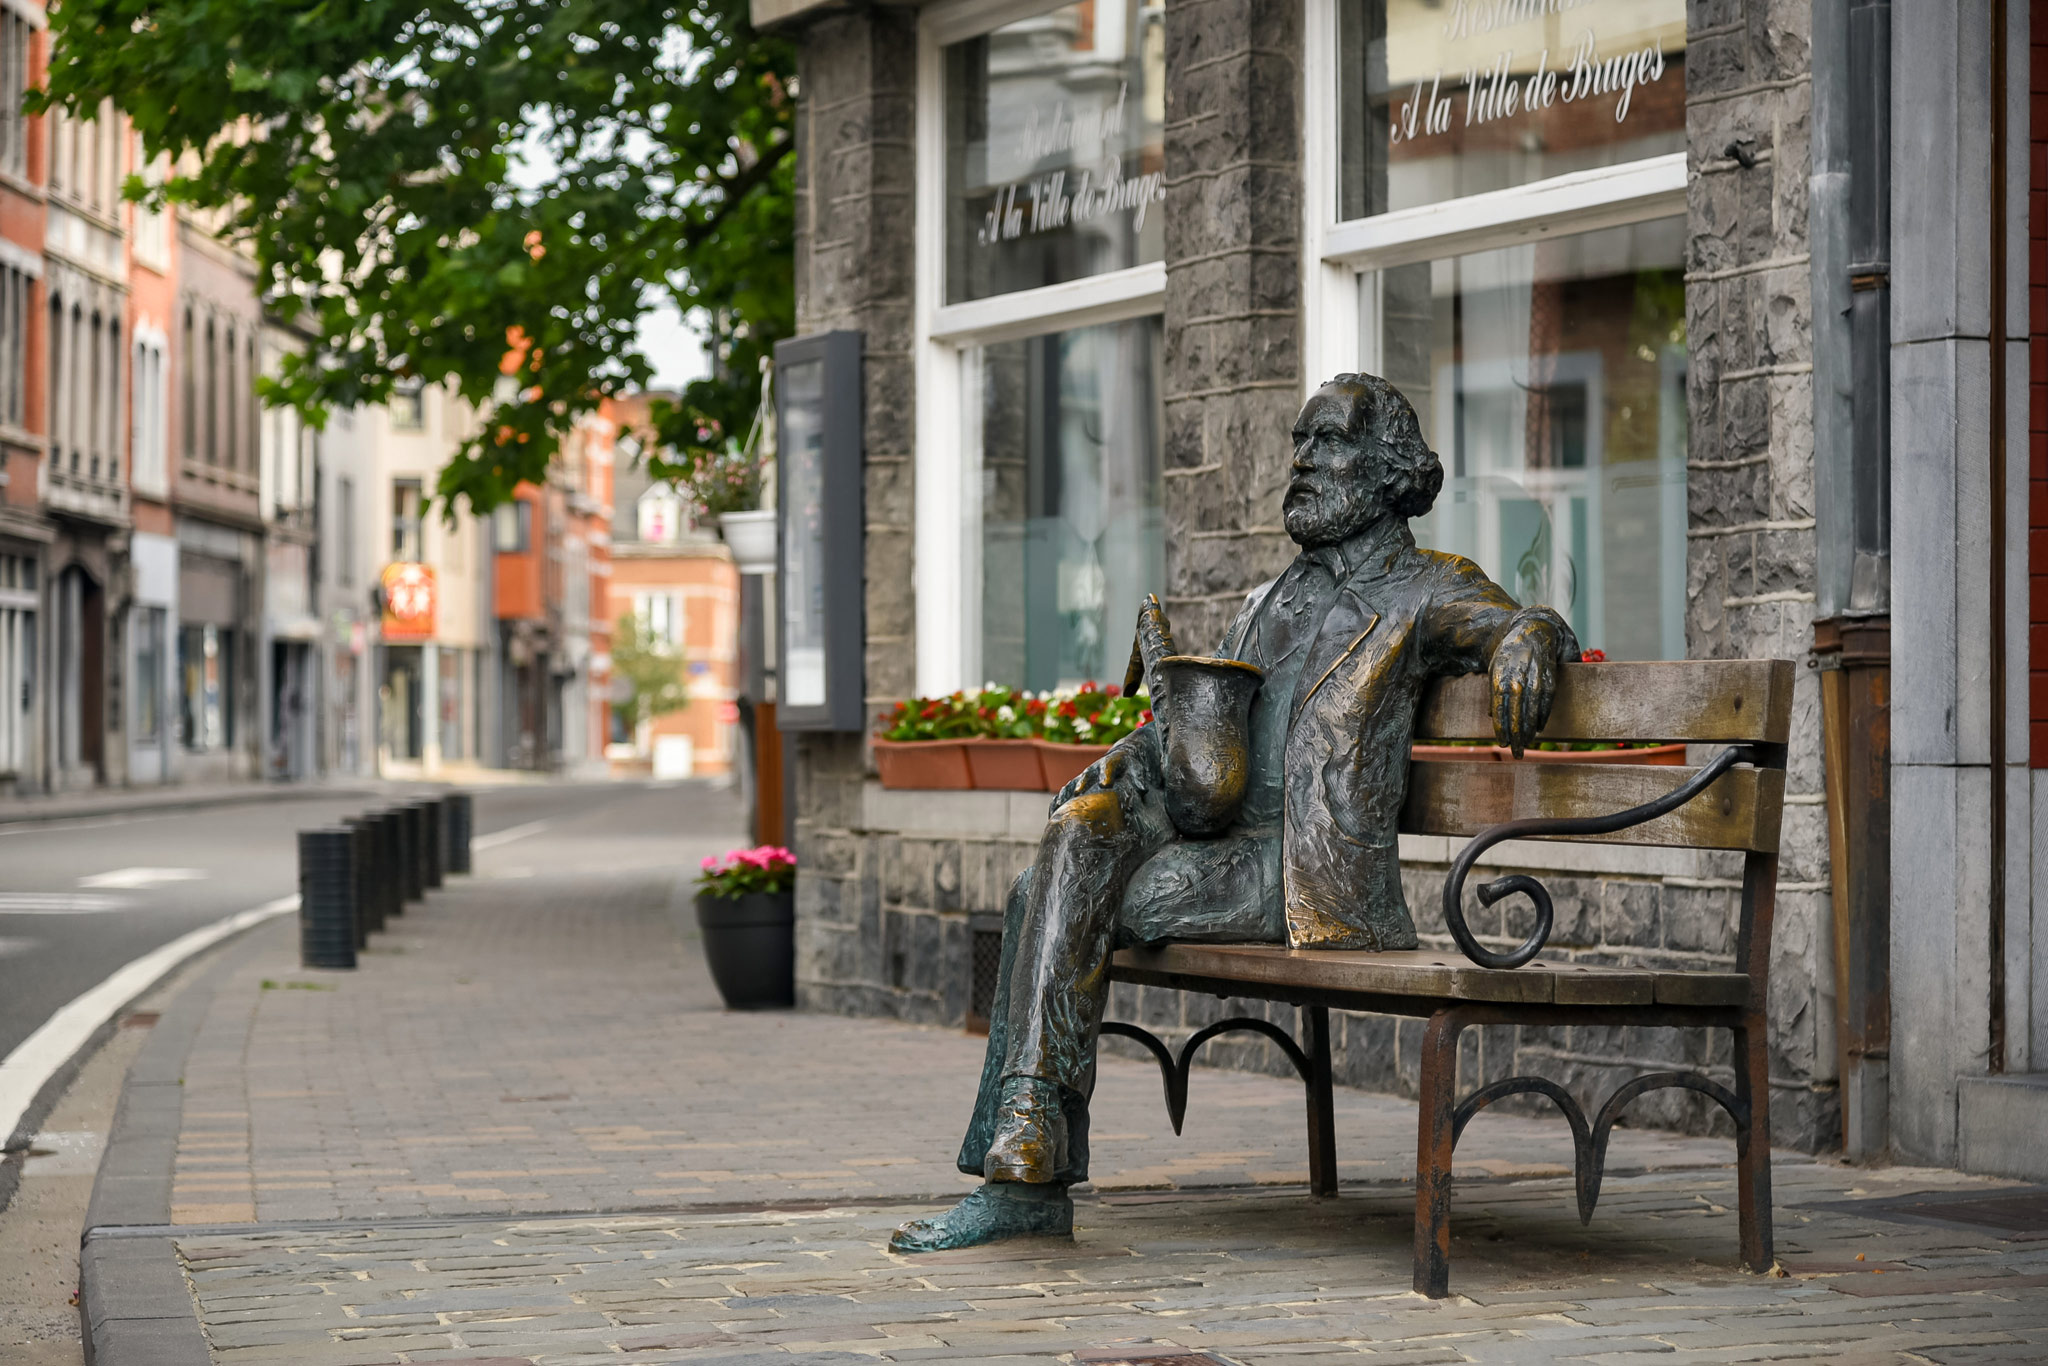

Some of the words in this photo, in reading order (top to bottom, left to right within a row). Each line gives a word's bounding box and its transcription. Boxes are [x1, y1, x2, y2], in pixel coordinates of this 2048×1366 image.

[1391, 76, 1422, 144] A
[1425, 68, 1452, 136] la
[1460, 51, 1519, 128] Ville
[1524, 49, 1557, 113] de
[1561, 26, 1666, 123] Bruges
[1029, 170, 1069, 234] Ville
[1070, 169, 1096, 224] de
